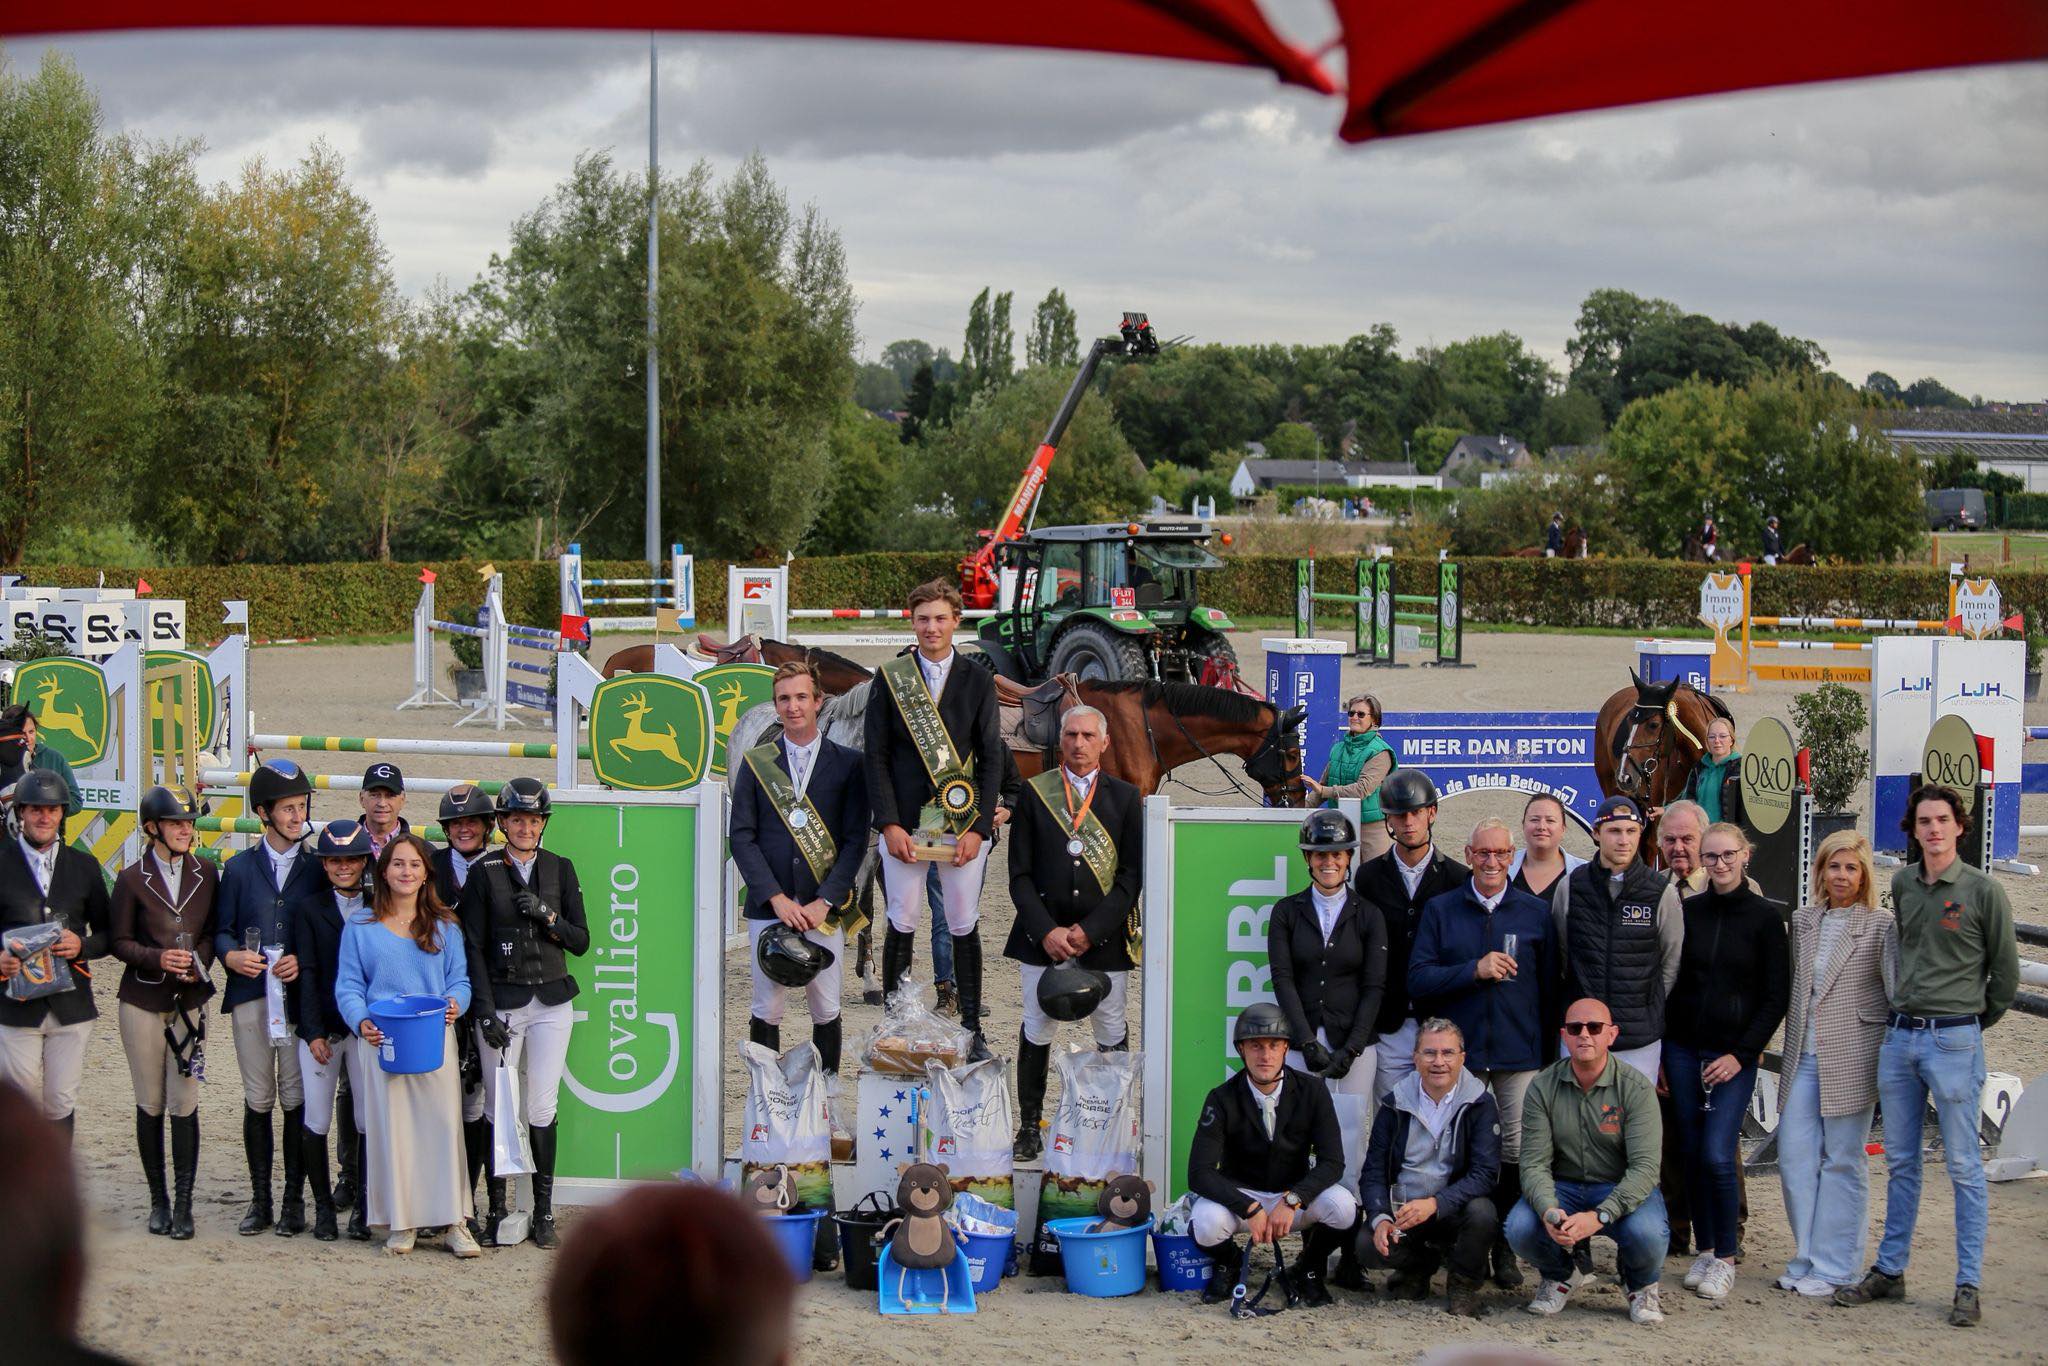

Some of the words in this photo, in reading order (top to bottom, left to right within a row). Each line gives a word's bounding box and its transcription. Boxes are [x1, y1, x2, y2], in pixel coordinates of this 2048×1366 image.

[1014, 465, 1044, 517] MANITOU
[1121, 598, 1132, 606] 344
[1705, 594, 1739, 604] Immo
[1960, 600, 1995, 609] Immo
[1712, 605, 1733, 614] Lot
[1967, 611, 1988, 620] Lot
[1299, 674, 1309, 696] Van
[1961, 683, 2000, 697] LJH
[1403, 739, 1462, 755] MEER
[1468, 739, 1510, 755] DAN
[1517, 738, 1586, 755] BETON
[1745, 753, 1791, 796] Q&O
[1926, 750, 1974, 787] Q&O
[1446, 779, 1464, 794] de
[1467, 773, 1507, 787] Velde
[1510, 774, 1550, 794] Beton
[80, 788, 121, 803] ERE
[1622, 905, 1652, 919] SDB
[1075, 1101, 1112, 1114] HORSE
